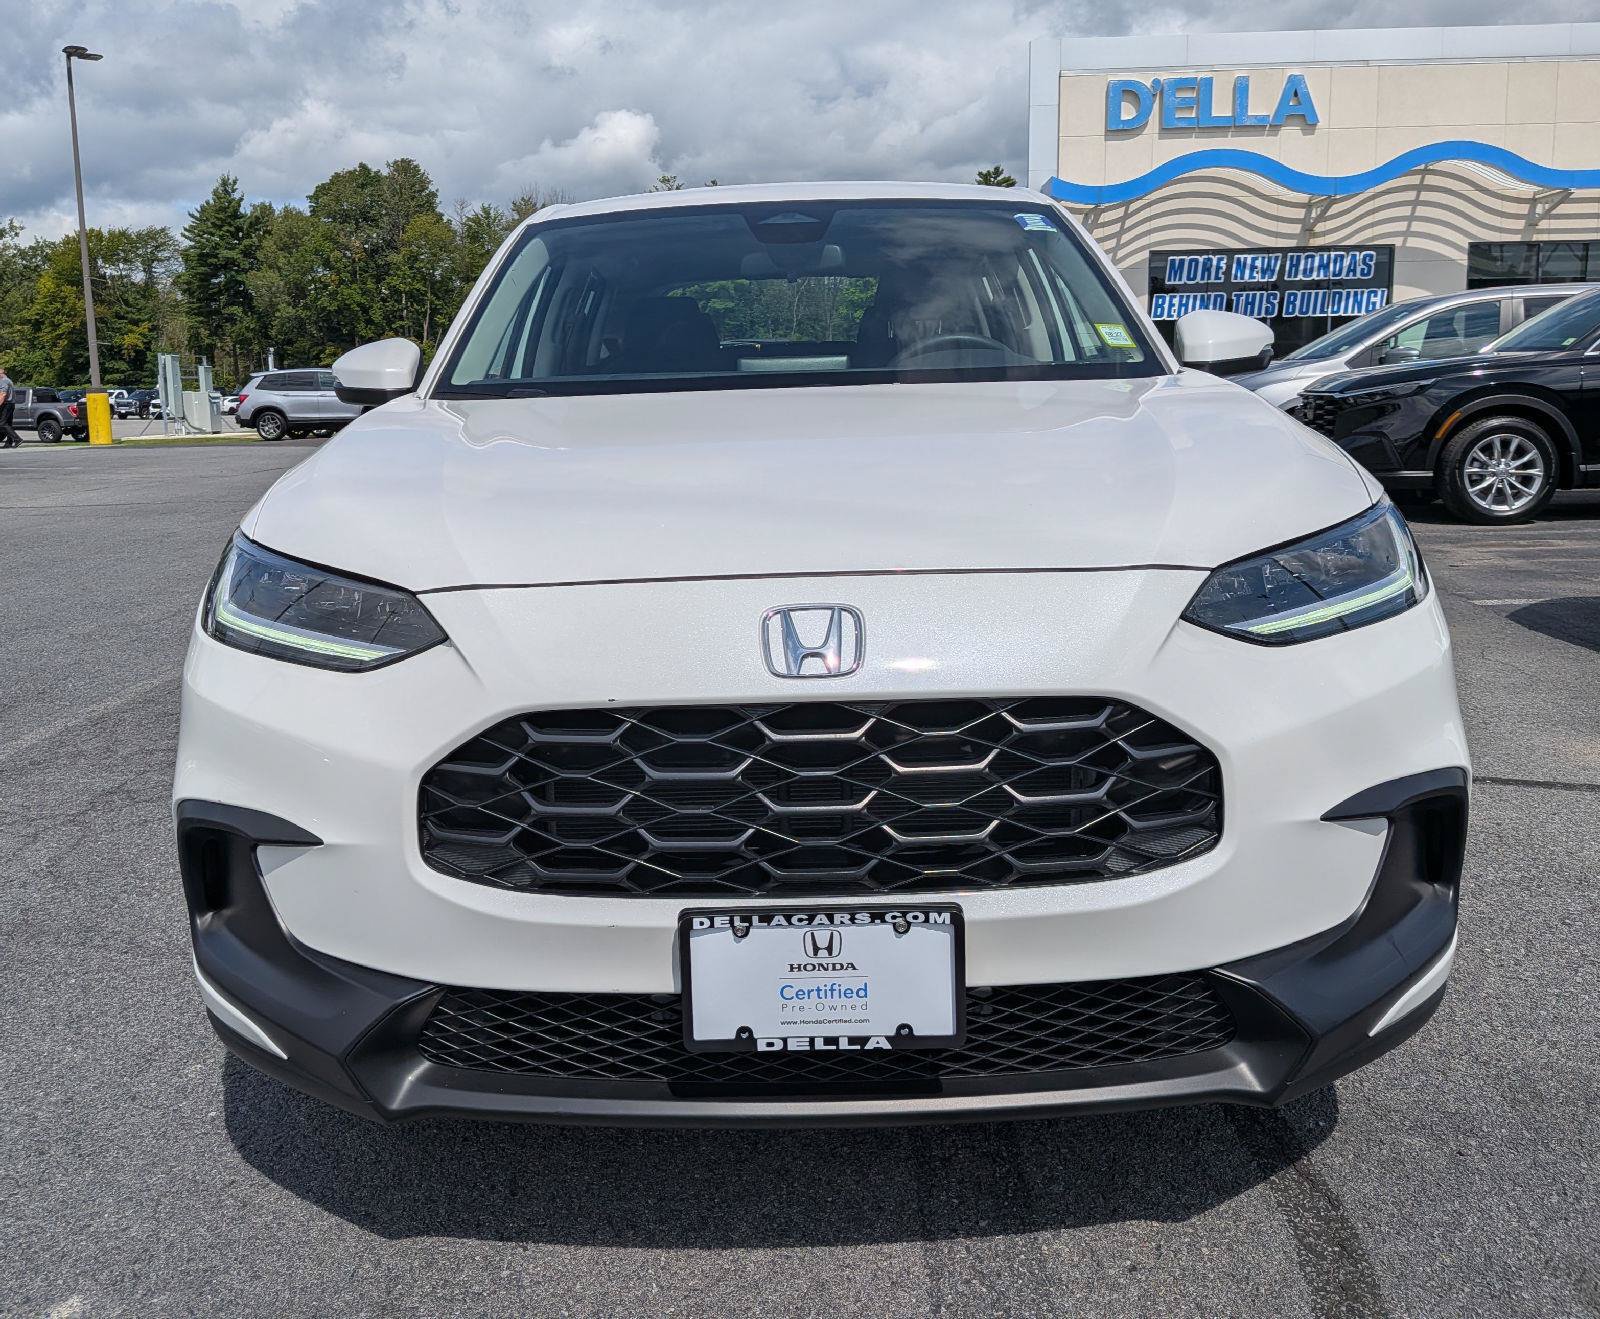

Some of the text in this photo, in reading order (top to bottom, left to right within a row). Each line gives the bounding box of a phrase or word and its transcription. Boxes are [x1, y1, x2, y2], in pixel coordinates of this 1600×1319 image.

[1106, 74, 1320, 131] D'ELLA
[1165, 251, 1377, 284] MORE NEW HONDAS
[1151, 288, 1388, 320] BEHIND THIS BUILDING!
[692, 911, 951, 930] DELLACARS.COM
[787, 962, 859, 973] HONDA
[779, 982, 868, 1001] Certified
[781, 1001, 868, 1013] Pre-Owned
[780, 1018, 870, 1026] www.HondaCertified.com
[756, 1035, 893, 1052] DELLA
